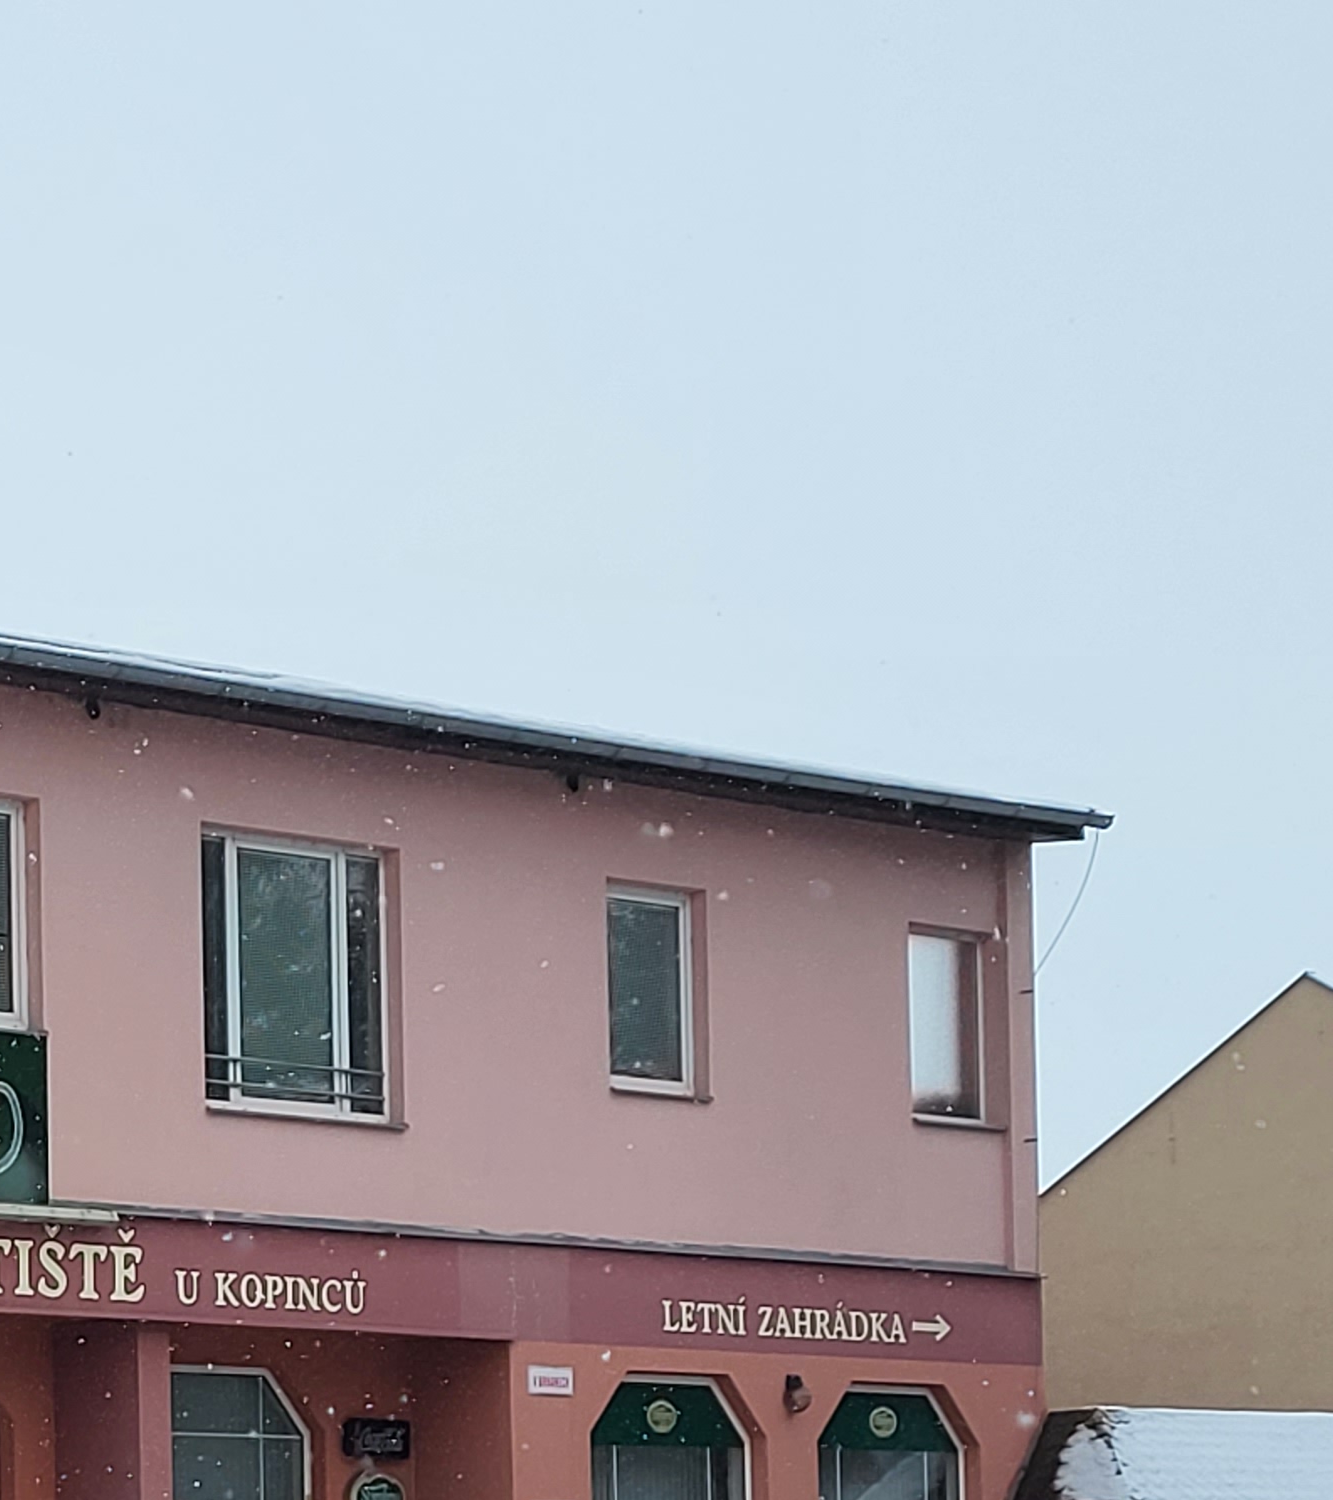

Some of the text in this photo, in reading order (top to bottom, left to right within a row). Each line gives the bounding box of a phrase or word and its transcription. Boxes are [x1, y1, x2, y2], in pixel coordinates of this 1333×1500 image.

[174, 1269, 201, 1305] U
[213, 1269, 367, 1315] KOPINCŮ
[661, 1296, 908, 1344] LETNÍ ZAHRÁDKA
